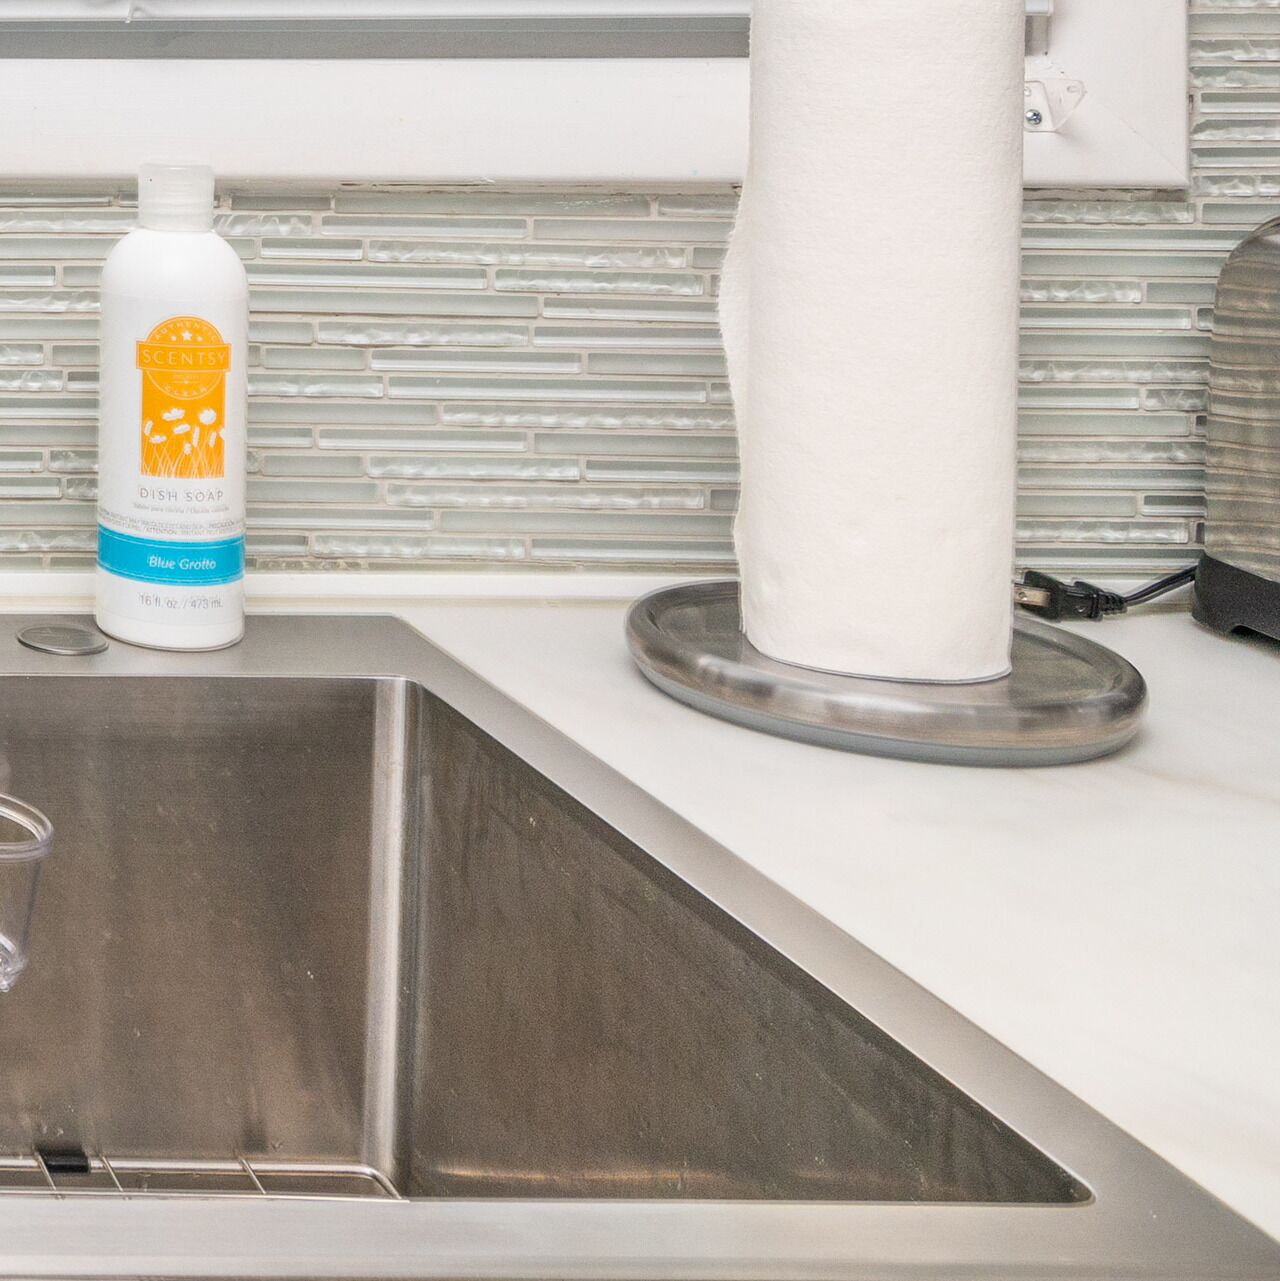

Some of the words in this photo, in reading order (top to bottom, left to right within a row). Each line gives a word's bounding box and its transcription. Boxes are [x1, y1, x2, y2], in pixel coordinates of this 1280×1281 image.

[143, 349, 226, 365] SCENTSY
[140, 487, 178, 501] DISH
[185, 490, 224, 502] SOAP
[149, 555, 176, 569] Blue
[179, 558, 216, 570] Grotto
[140, 595, 151, 606] 16
[190, 598, 209, 609] 473
